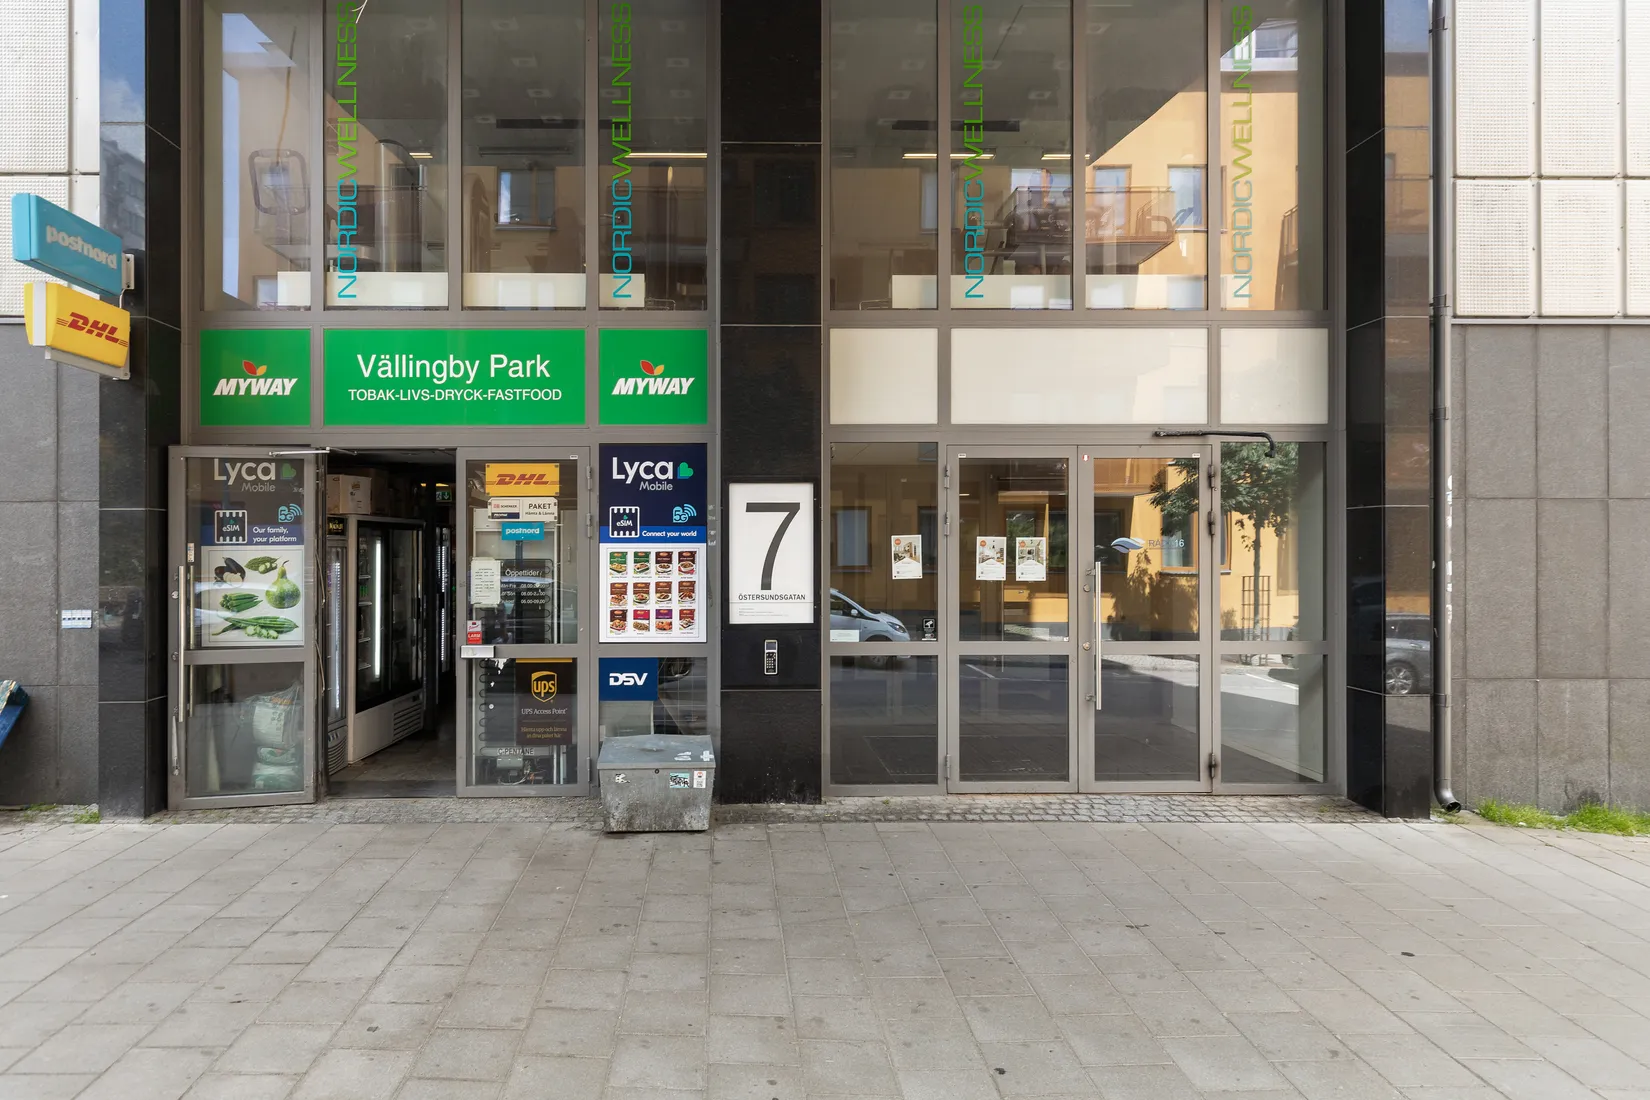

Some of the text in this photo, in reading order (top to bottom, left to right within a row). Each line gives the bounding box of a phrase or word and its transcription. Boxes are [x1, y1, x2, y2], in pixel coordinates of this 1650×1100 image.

[46, 224, 117, 270] postnord
[67, 311, 121, 344] DHL
[357, 354, 551, 384] Vällingby Park
[213, 378, 298, 396] MYWAY
[348, 389, 562, 401] TOBAK-LIVS-DRYCK-FASTFOOD
[612, 377, 695, 395] MYWAY
[214, 458, 276, 486] Lyca
[612, 456, 674, 484] Lyca
[241, 482, 276, 492] Mobile
[496, 474, 549, 486] DHL
[639, 481, 674, 491] Mobile
[746, 502, 800, 590] 7
[1174, 539, 1185, 548] 16
[609, 673, 648, 686] DSV
[533, 681, 555, 697] ups
